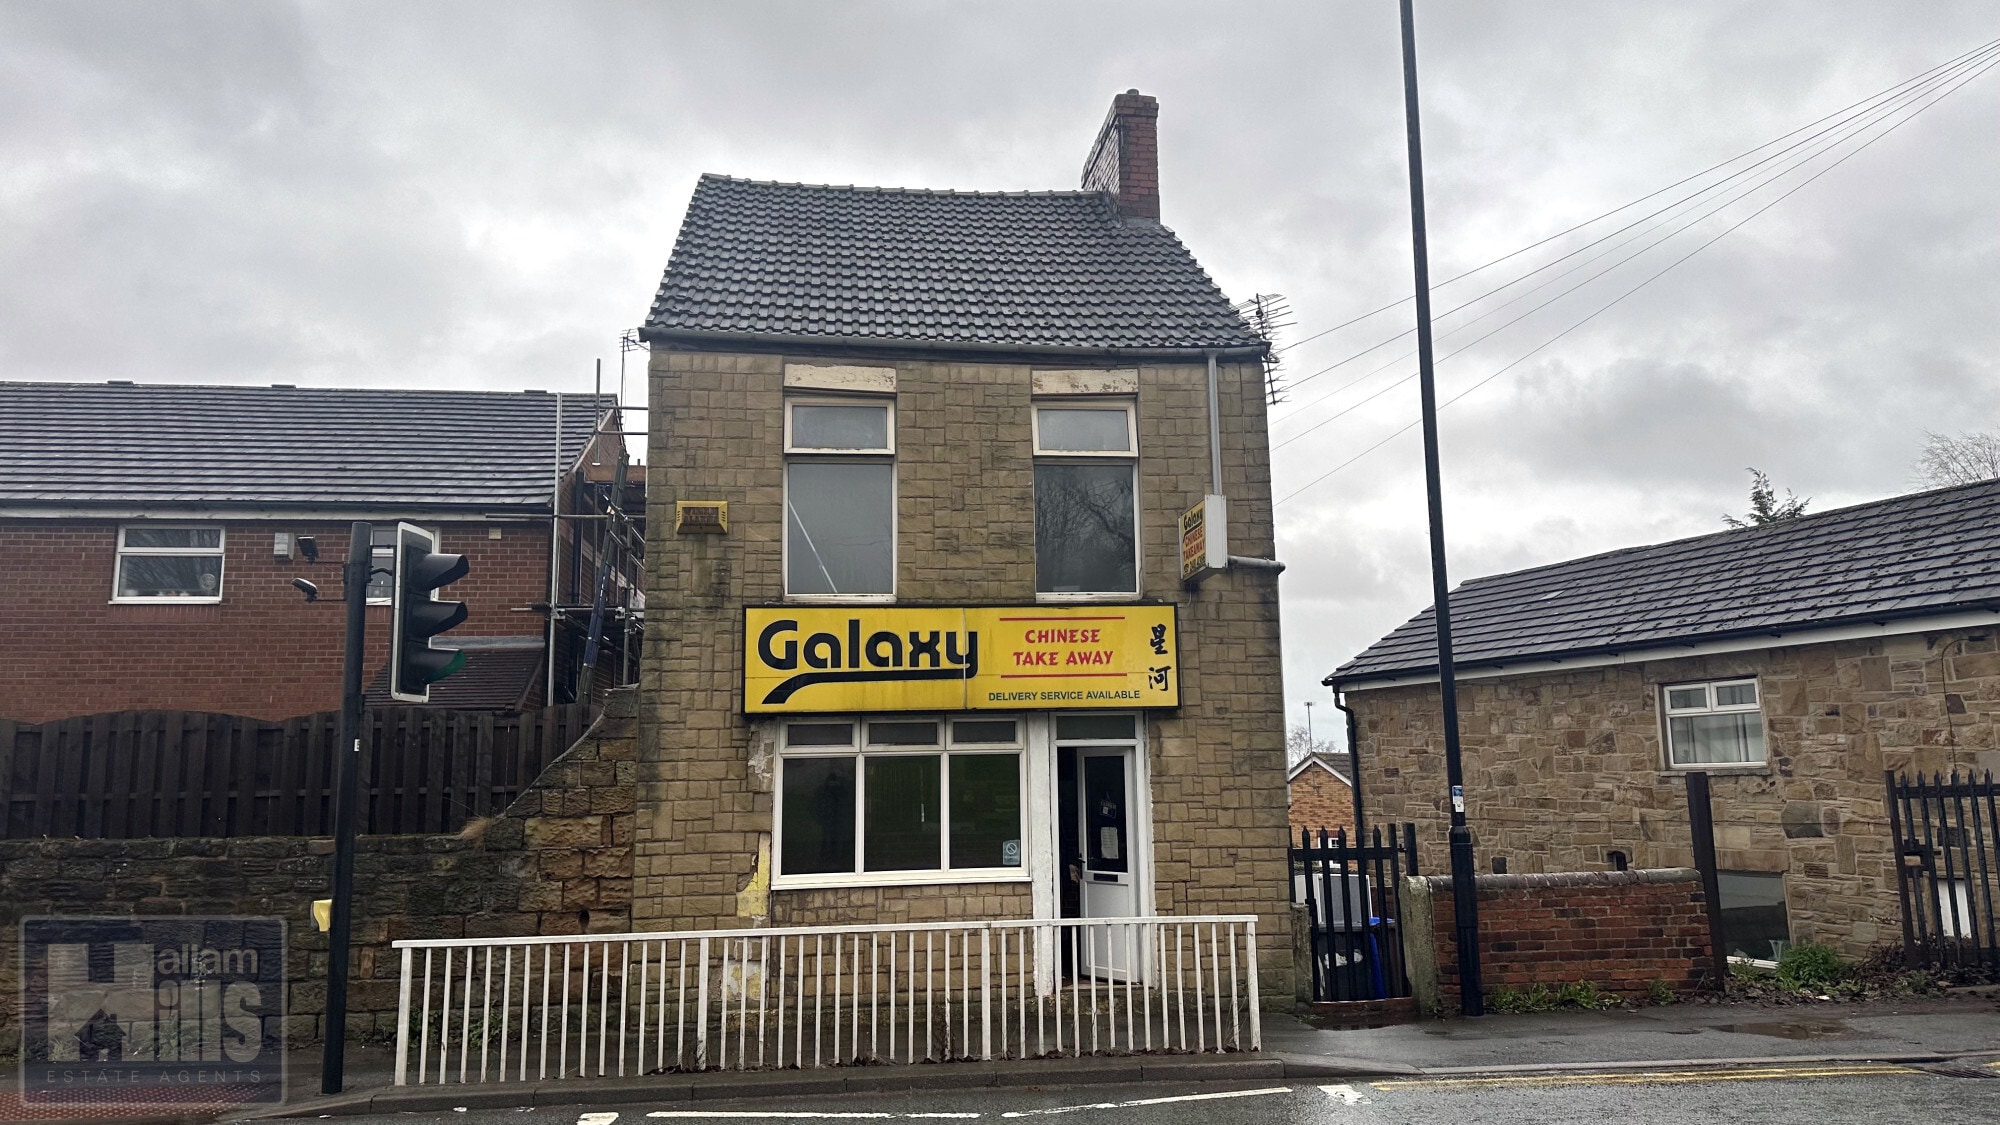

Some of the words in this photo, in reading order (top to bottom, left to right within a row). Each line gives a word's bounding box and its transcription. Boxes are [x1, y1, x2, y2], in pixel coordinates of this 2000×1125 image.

[1024, 628, 1101, 644] CHINESE
[757, 619, 979, 680] Galaxy
[1012, 651, 1059, 666] TAKE
[1065, 650, 1114, 665] AWAY
[988, 692, 1038, 701] DELIVERY
[1040, 691, 1083, 700] SERVICE
[1086, 690, 1140, 700] AVAILABLE
